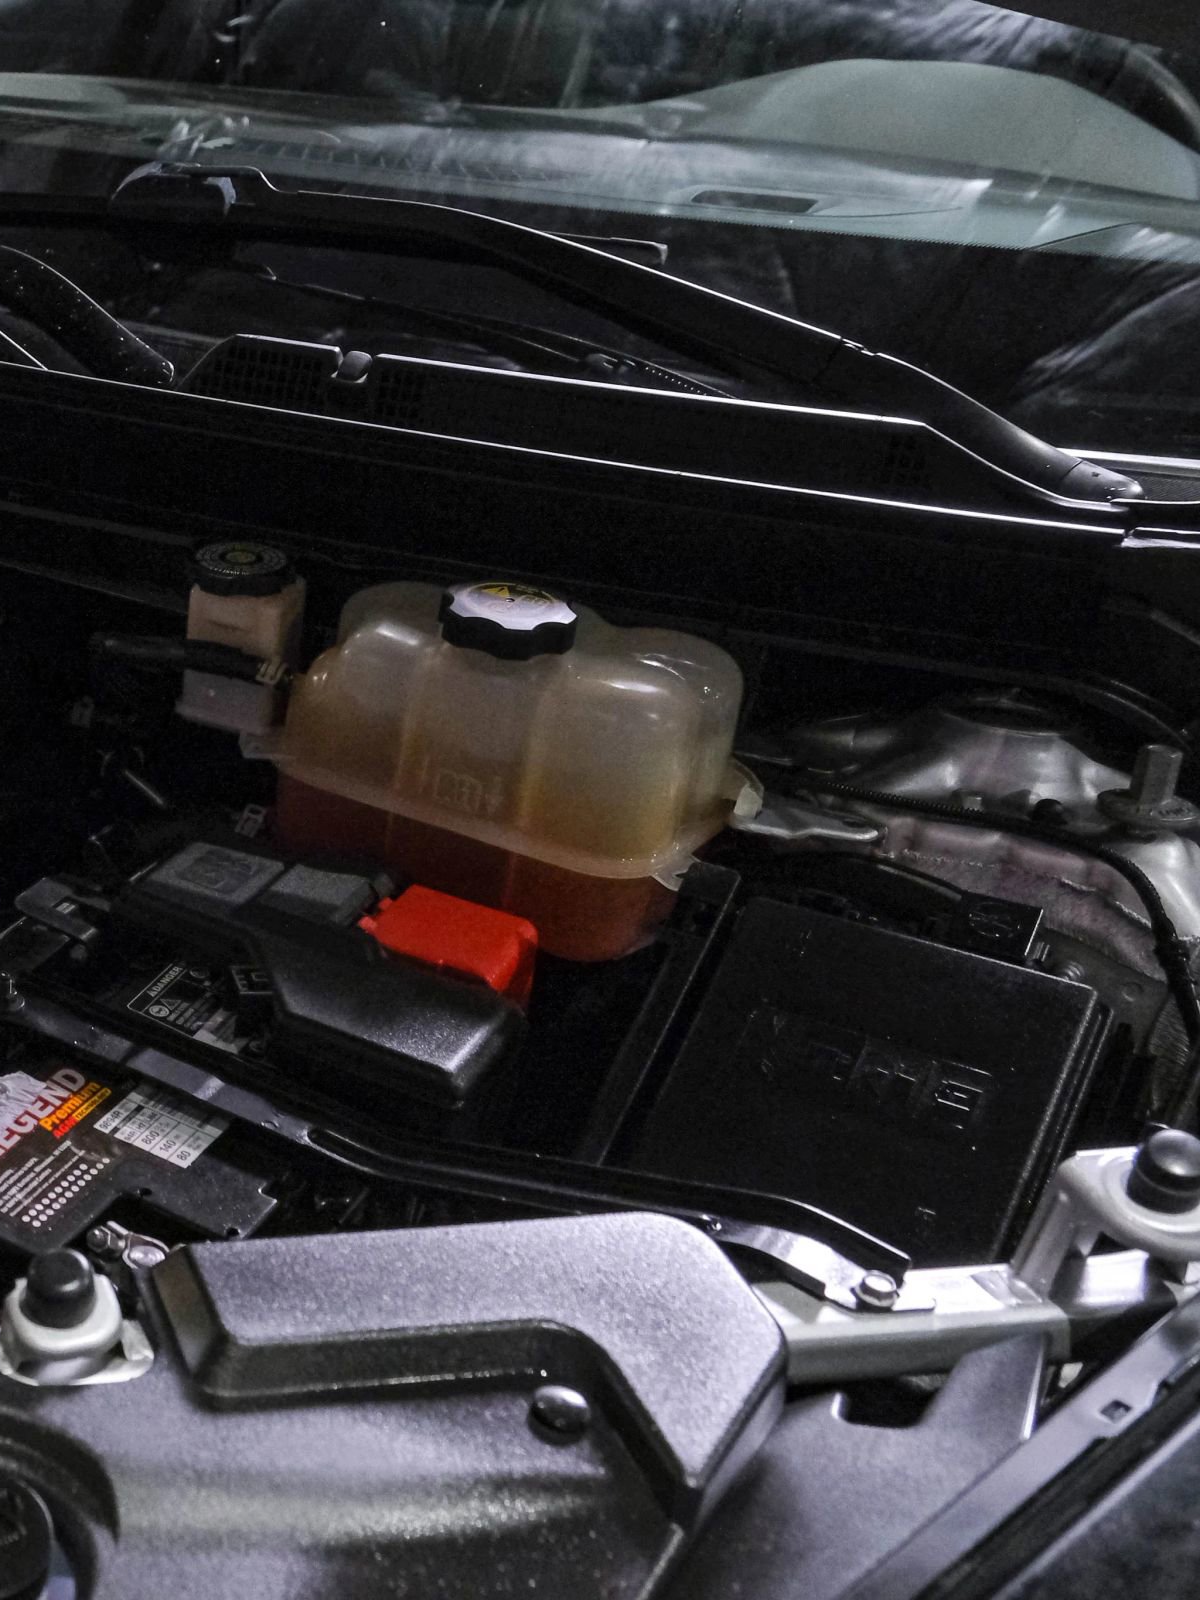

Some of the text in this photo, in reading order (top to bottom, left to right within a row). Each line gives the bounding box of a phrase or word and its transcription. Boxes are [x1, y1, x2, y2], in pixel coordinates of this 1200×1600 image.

[154, 966, 183, 993] DANGER
[39, 1082, 101, 1131] Premium
[141, 1130, 160, 1145] 800
[160, 1140, 177, 1153] 140
[176, 1150, 191, 1161] 80
